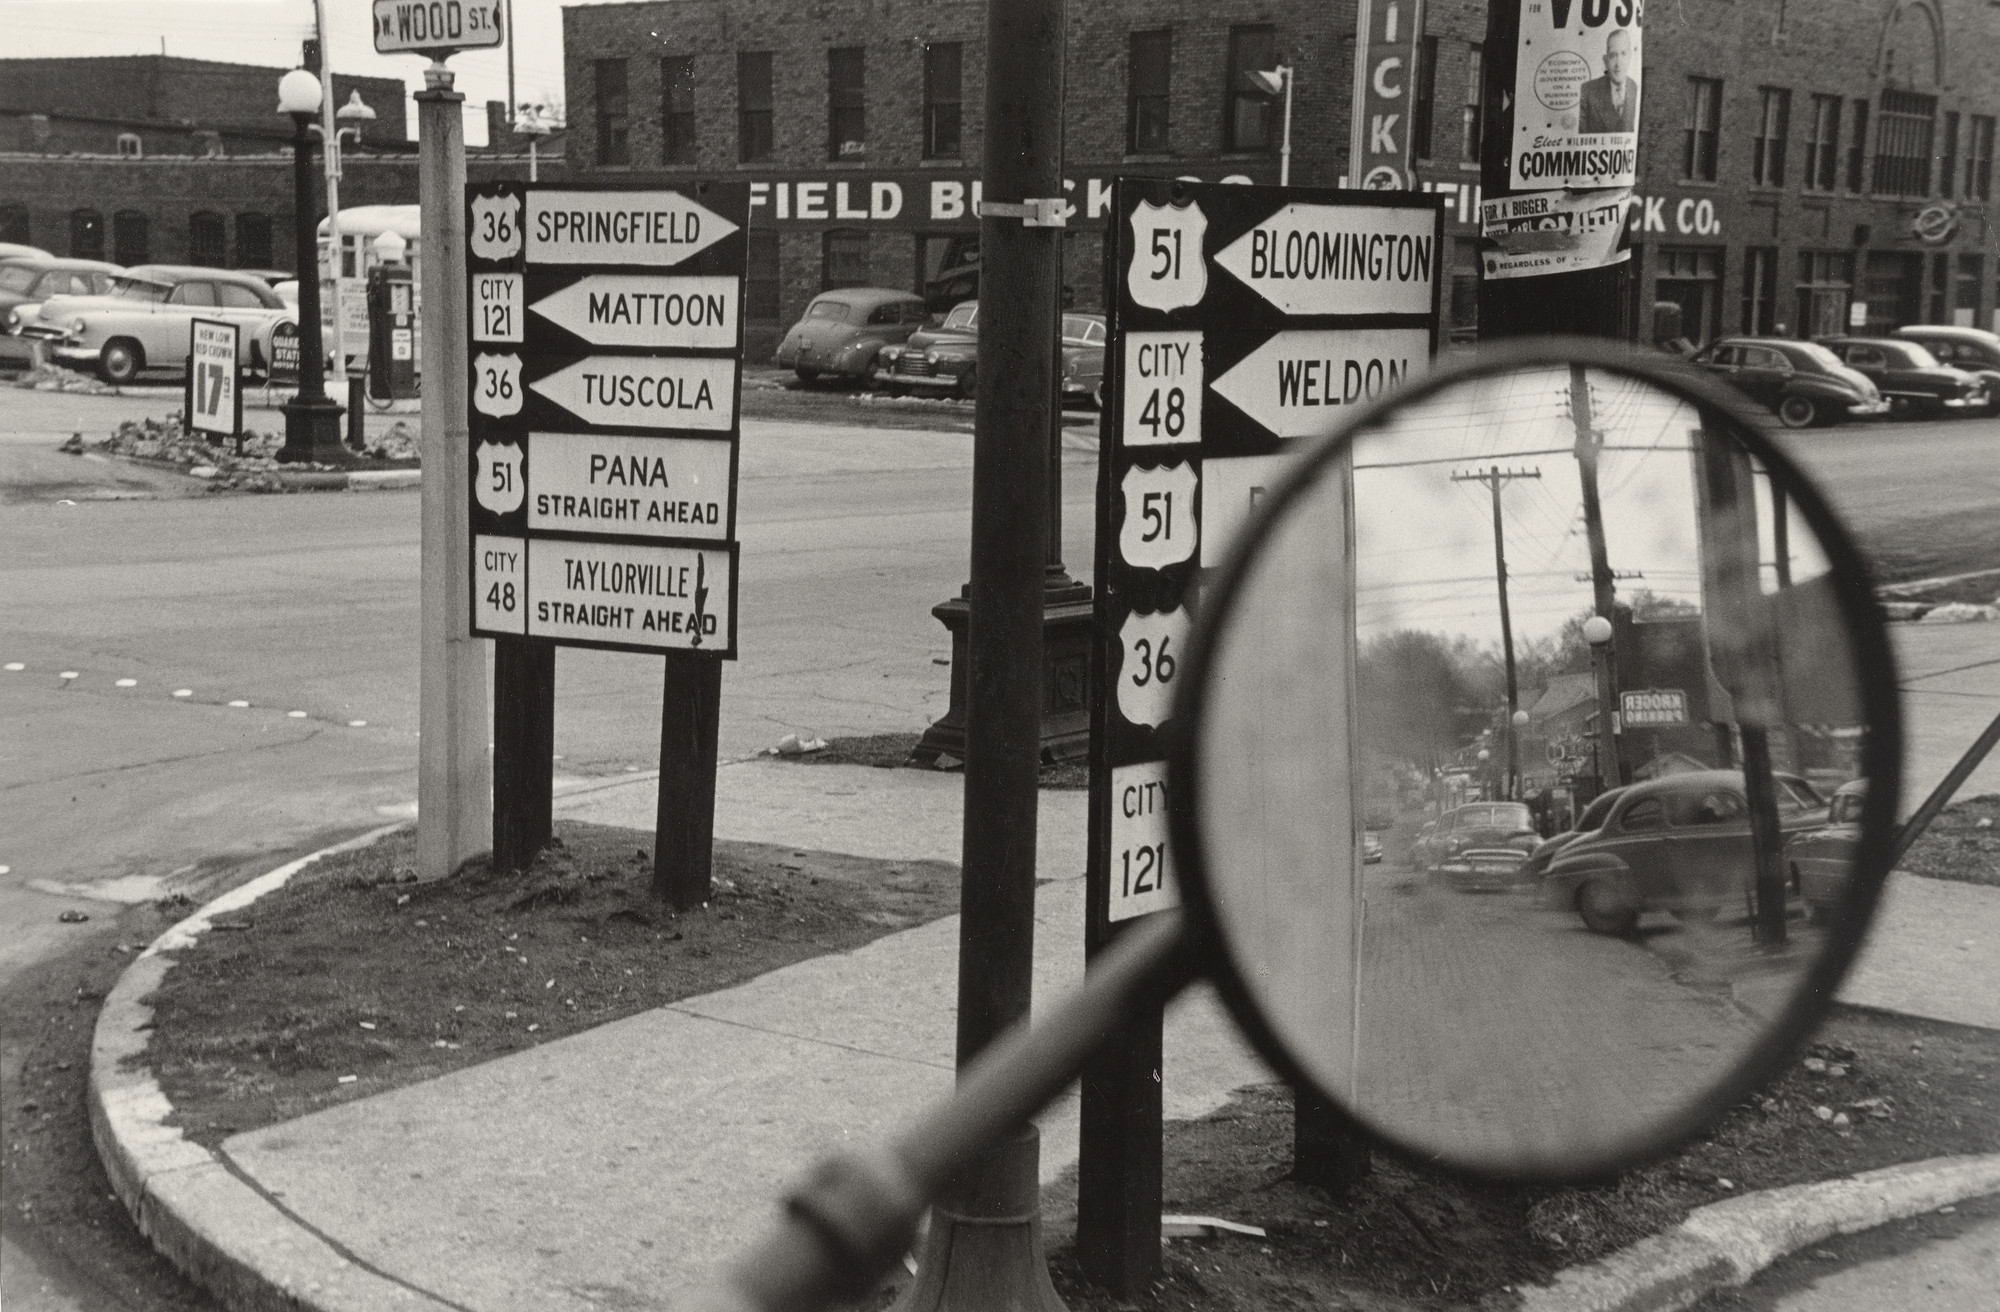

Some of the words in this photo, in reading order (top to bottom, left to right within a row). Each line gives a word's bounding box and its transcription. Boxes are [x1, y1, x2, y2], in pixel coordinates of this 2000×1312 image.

[381, 14, 394, 36] W.
[396, 1, 461, 42] WOOD
[468, 7, 491, 30] ST.
[1533, 136, 1563, 149] Elect
[750, 182, 903, 219] FIELD
[1484, 204, 1498, 220] FOR
[1502, 203, 1508, 217] A
[1512, 198, 1548, 216] BIGGER
[1676, 199, 1720, 235] CO.
[483, 211, 511, 242] 36
[537, 211, 700, 243] SPRINGFIELD
[1150, 229, 1182, 281] 51
[1251, 229, 1432, 282] BLOOMINGTON
[1499, 258, 1551, 270] REGARDLESS
[1556, 256, 1566, 264] OF
[481, 279, 513, 300] CITY
[484, 305, 511, 336] 121
[589, 292, 724, 326] MATTOON
[1138, 343, 1190, 378] CITY
[485, 369, 513, 399] 36
[583, 374, 713, 410] TUSCOLA
[1278, 359, 1407, 407] WELDON
[1139, 387, 1185, 437] 48
[492, 462, 511, 492] 51
[590, 454, 668, 488] PANA
[537, 494, 640, 520] STRAIGHT
[647, 501, 718, 524] AHEAD
[1141, 491, 1172, 542] 51
[485, 551, 517, 573] CITY
[565, 559, 689, 598] TAYLORVILLE
[487, 582, 516, 612] 48
[538, 601, 634, 629] STRAIGHT
[643, 609, 717, 635] AHEAD
[1132, 635, 1176, 687] 36
[1123, 781, 1168, 818] CITY
[1122, 841, 1164, 898] 121
